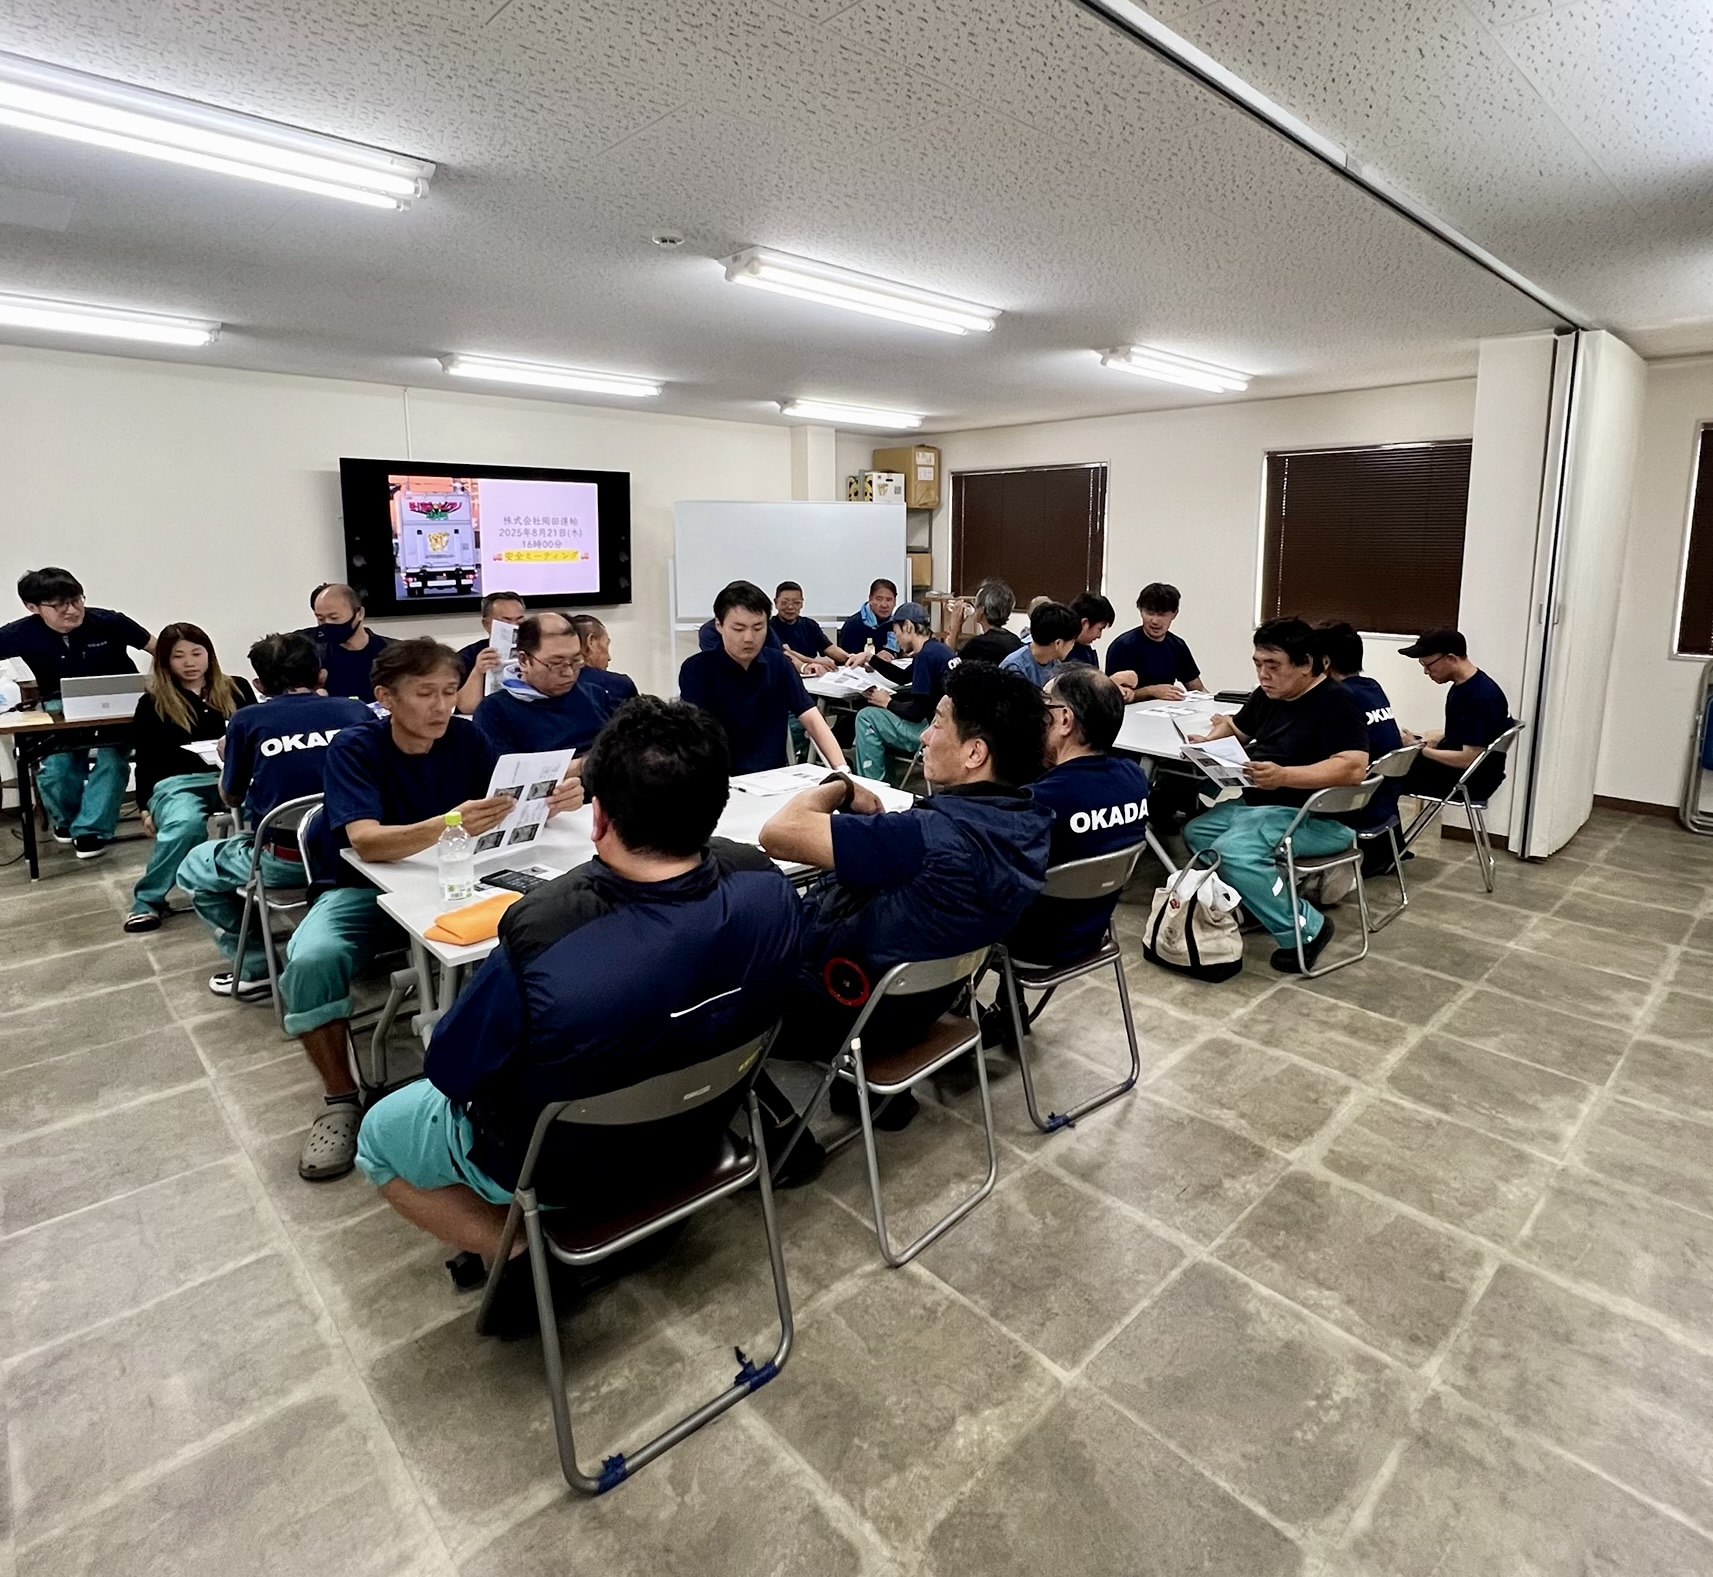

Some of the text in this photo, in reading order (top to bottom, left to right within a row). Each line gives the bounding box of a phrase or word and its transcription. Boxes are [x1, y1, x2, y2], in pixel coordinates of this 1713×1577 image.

[522, 540, 563, 549] 16時00分
[504, 550, 579, 561] 安全ミーティング
[1069, 798, 1149, 834] OKADA
